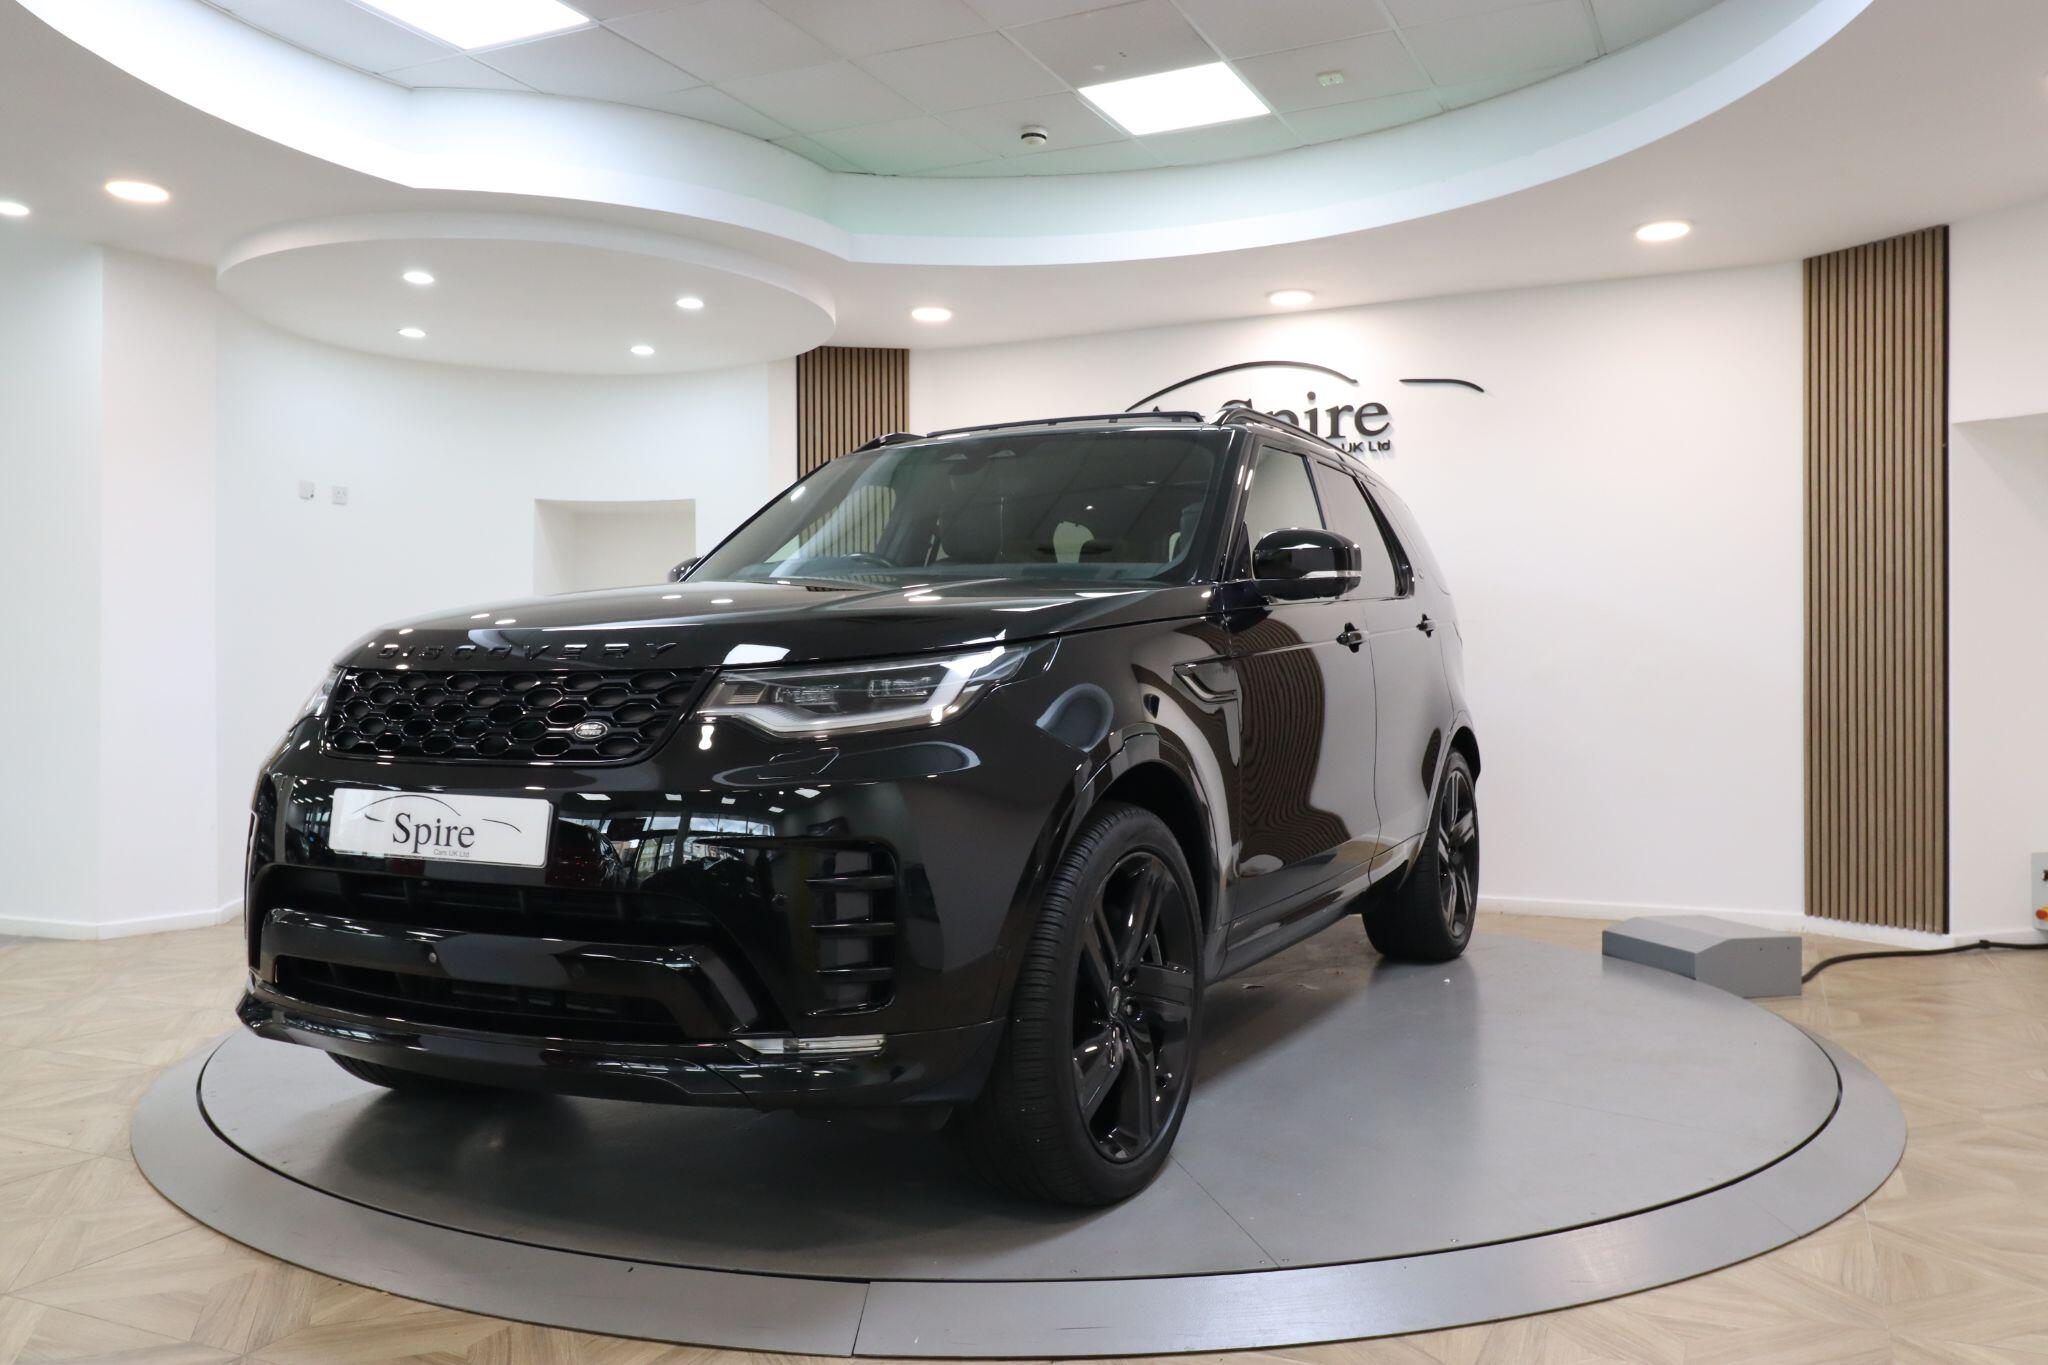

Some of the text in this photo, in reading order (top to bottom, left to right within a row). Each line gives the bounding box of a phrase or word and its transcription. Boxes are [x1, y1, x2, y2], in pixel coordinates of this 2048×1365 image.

[1221, 391, 1390, 439] ire
[1368, 440, 1391, 452] Ltd
[376, 641, 678, 662] DISCOVERY
[392, 812, 475, 854] Spire
[433, 848, 470, 858] Cars UK Ltd
